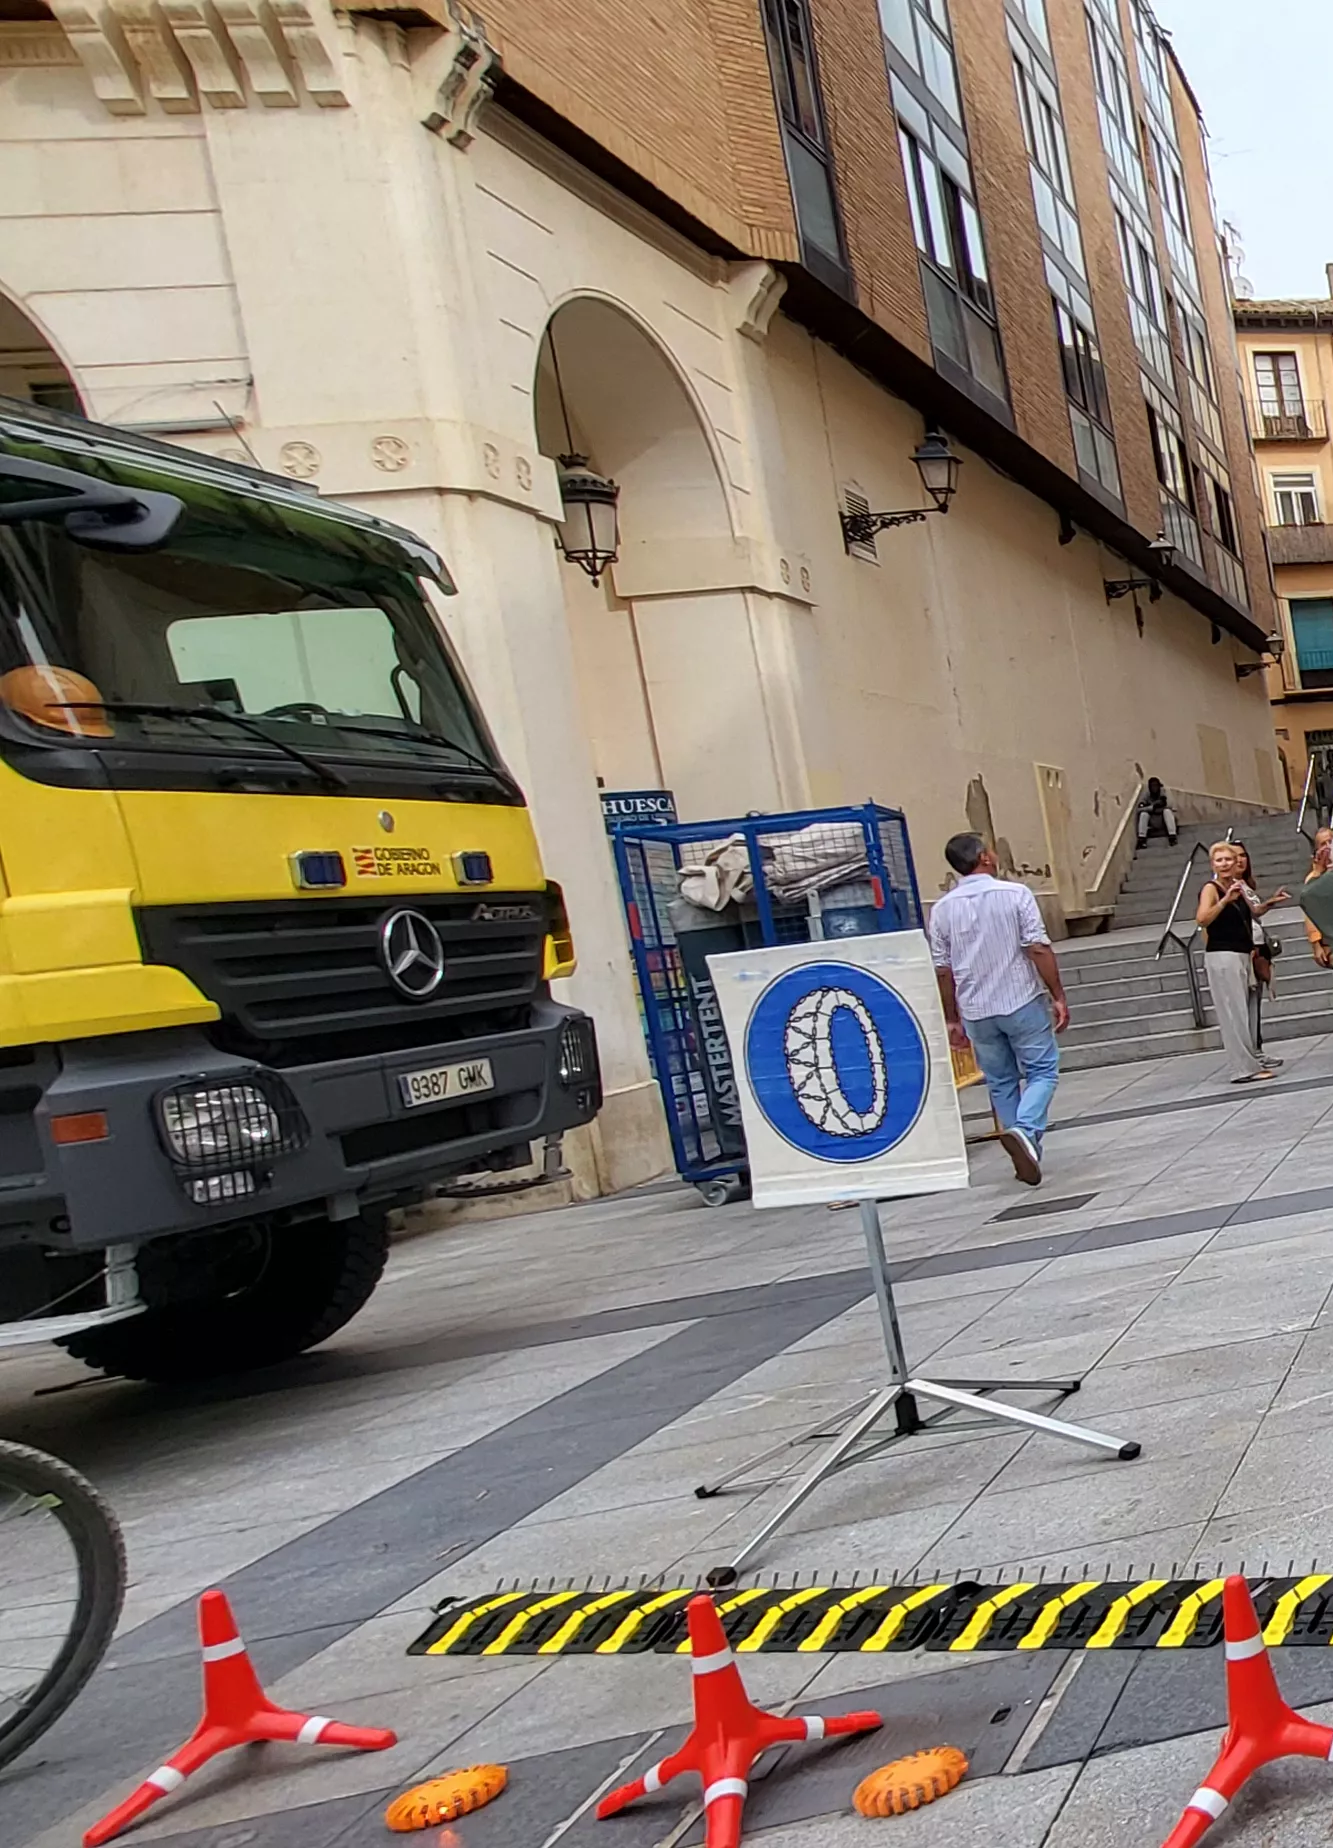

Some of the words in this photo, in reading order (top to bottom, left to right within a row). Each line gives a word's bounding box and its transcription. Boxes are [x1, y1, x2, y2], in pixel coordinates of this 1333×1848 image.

[601, 798, 675, 815] HUESCA
[374, 848, 431, 861] GOBIERNO
[377, 863, 393, 876] DE
[690, 972, 742, 1127] MASTERTENT
[411, 1070, 448, 1100] 9387
